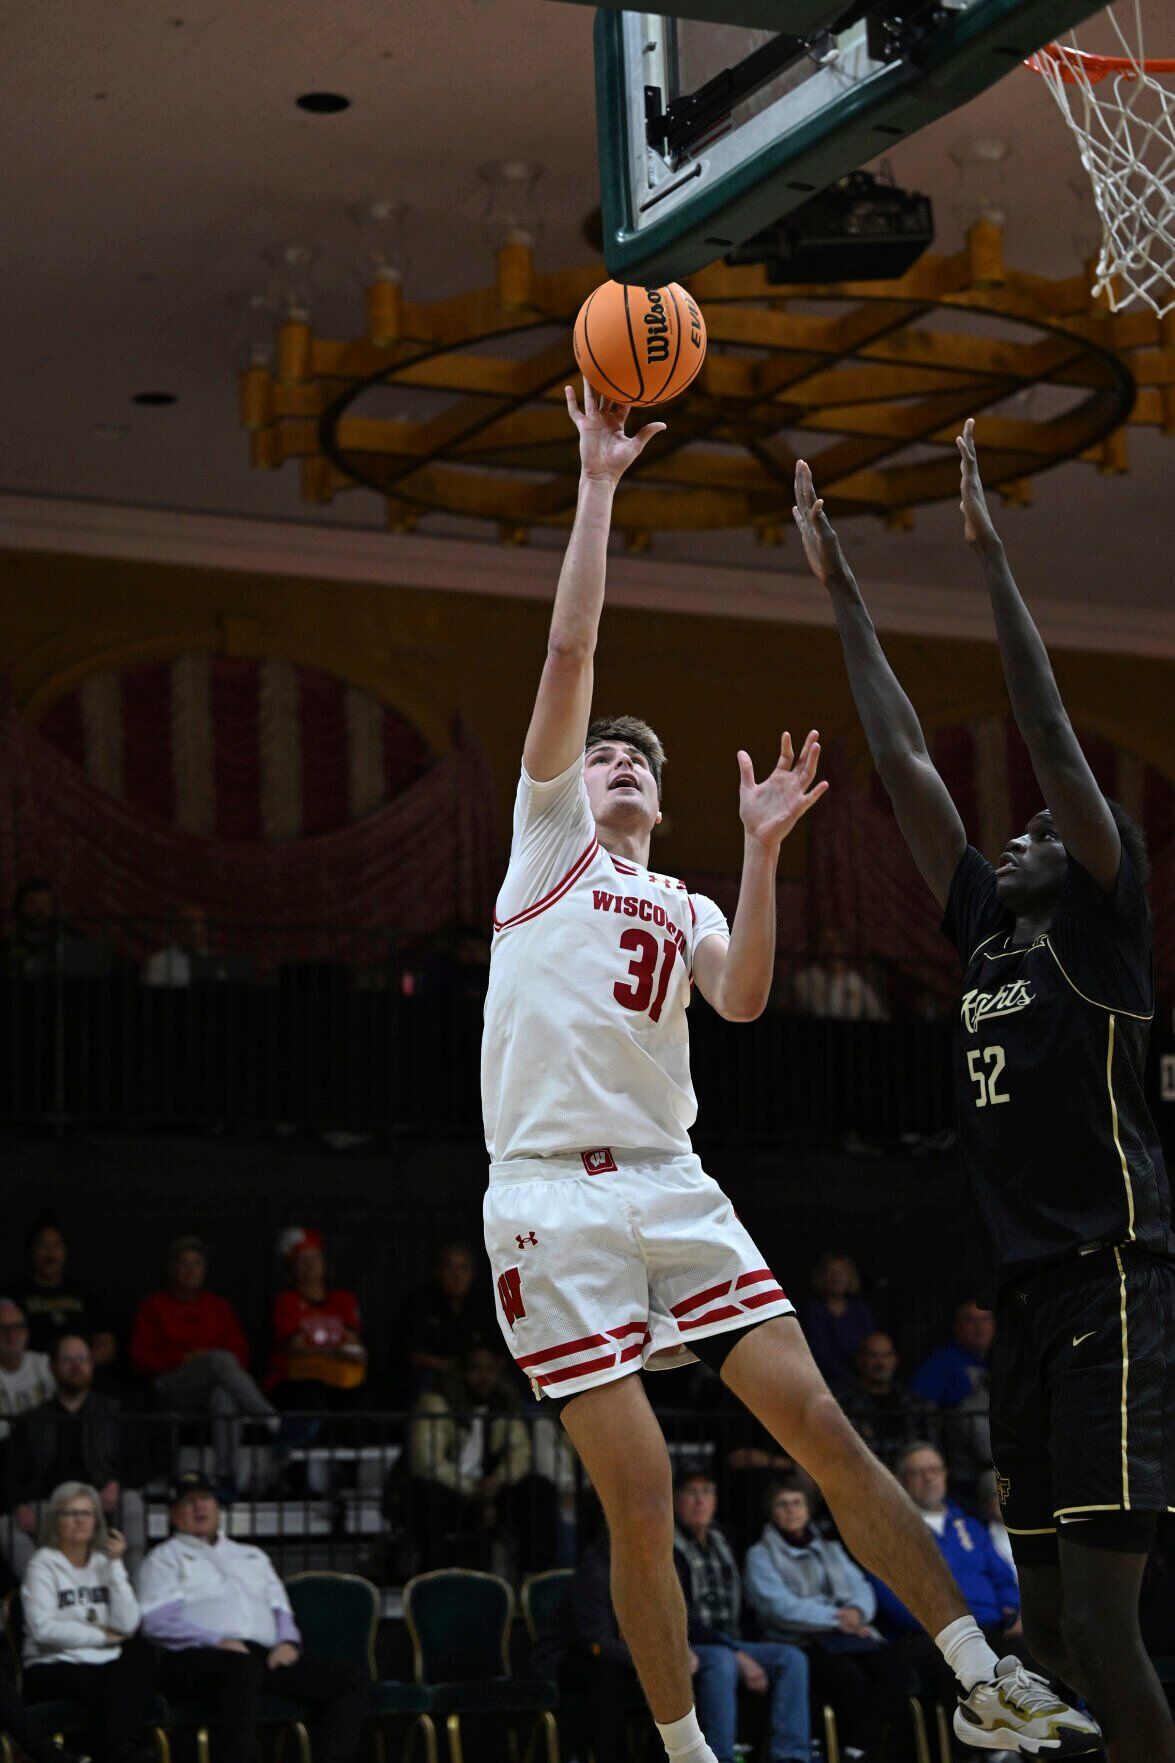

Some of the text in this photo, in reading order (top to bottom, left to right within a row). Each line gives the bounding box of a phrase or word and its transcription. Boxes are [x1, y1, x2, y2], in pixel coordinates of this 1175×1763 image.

[644, 284, 670, 365] Wilso
[592, 890, 687, 956] WISCO
[613, 928, 677, 1023] 31
[966, 1045, 1011, 1108] 52
